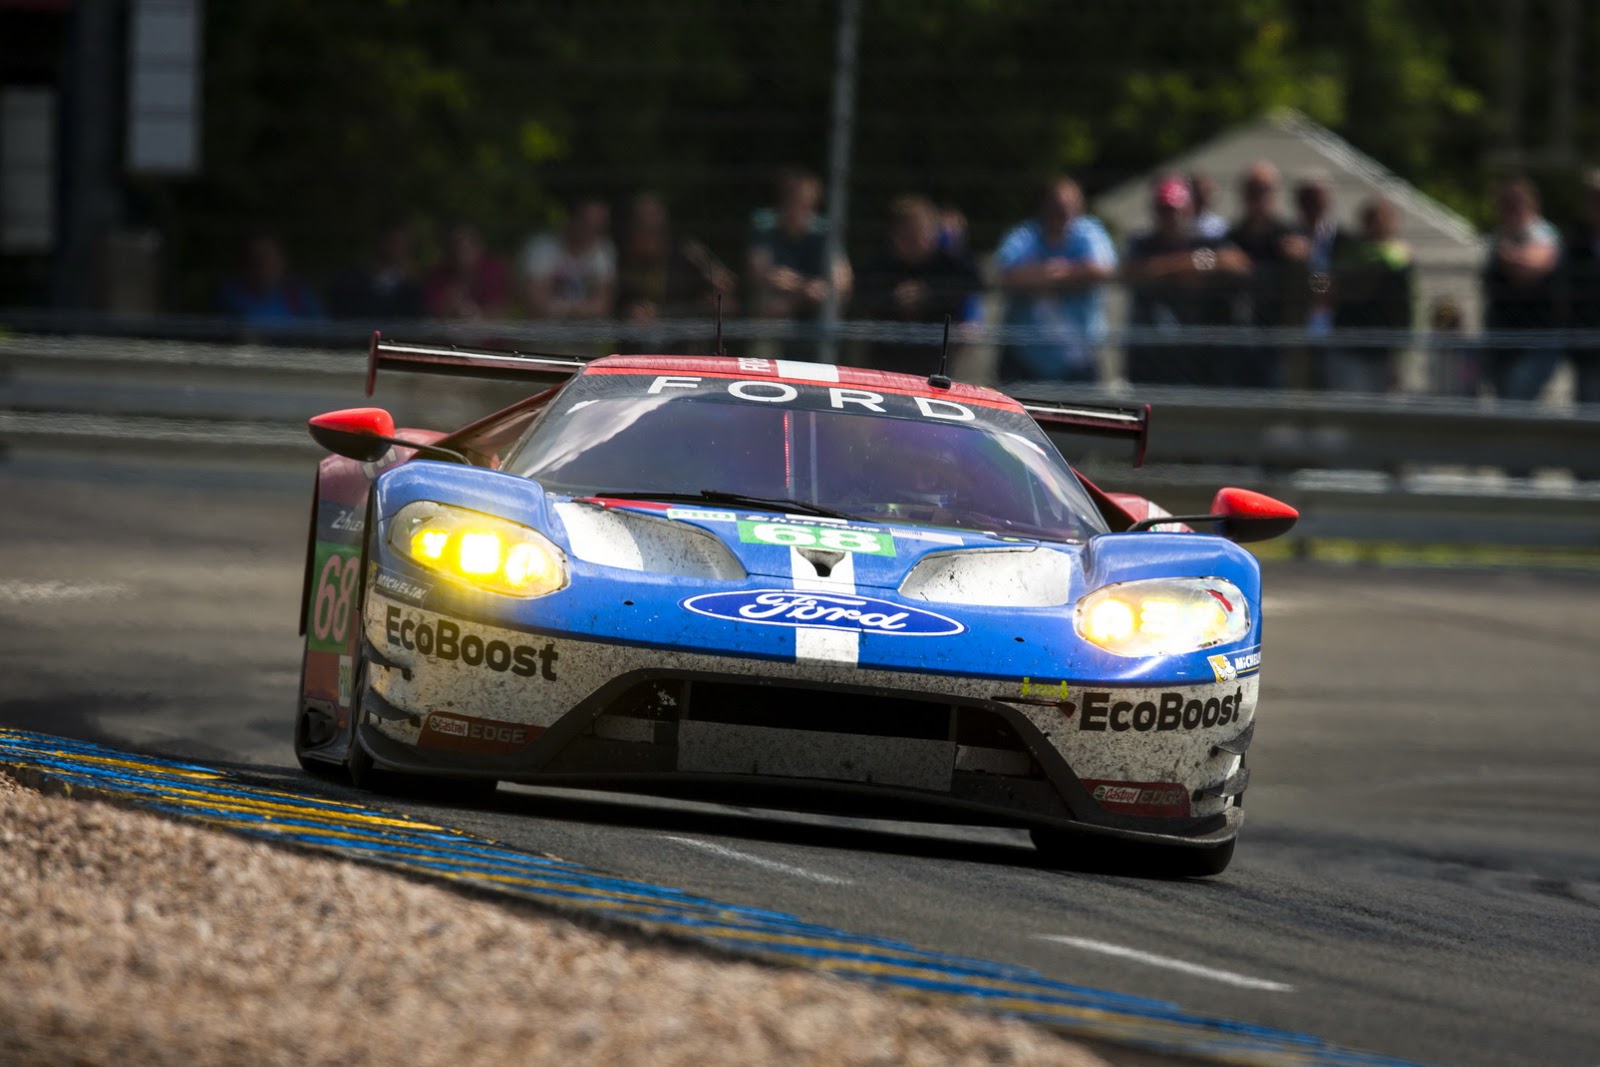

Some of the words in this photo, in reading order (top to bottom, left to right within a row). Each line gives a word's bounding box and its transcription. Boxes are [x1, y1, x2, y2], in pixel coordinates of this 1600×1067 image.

[647, 376, 976, 421] FORD
[753, 523, 881, 552] 68
[314, 554, 360, 642] 68
[738, 593, 907, 629] Ford
[386, 604, 559, 682] EcoBoost
[1079, 685, 1243, 733] EcoBoost
[470, 723, 528, 744] EDGE
[1104, 788, 1137, 801] Castrol
